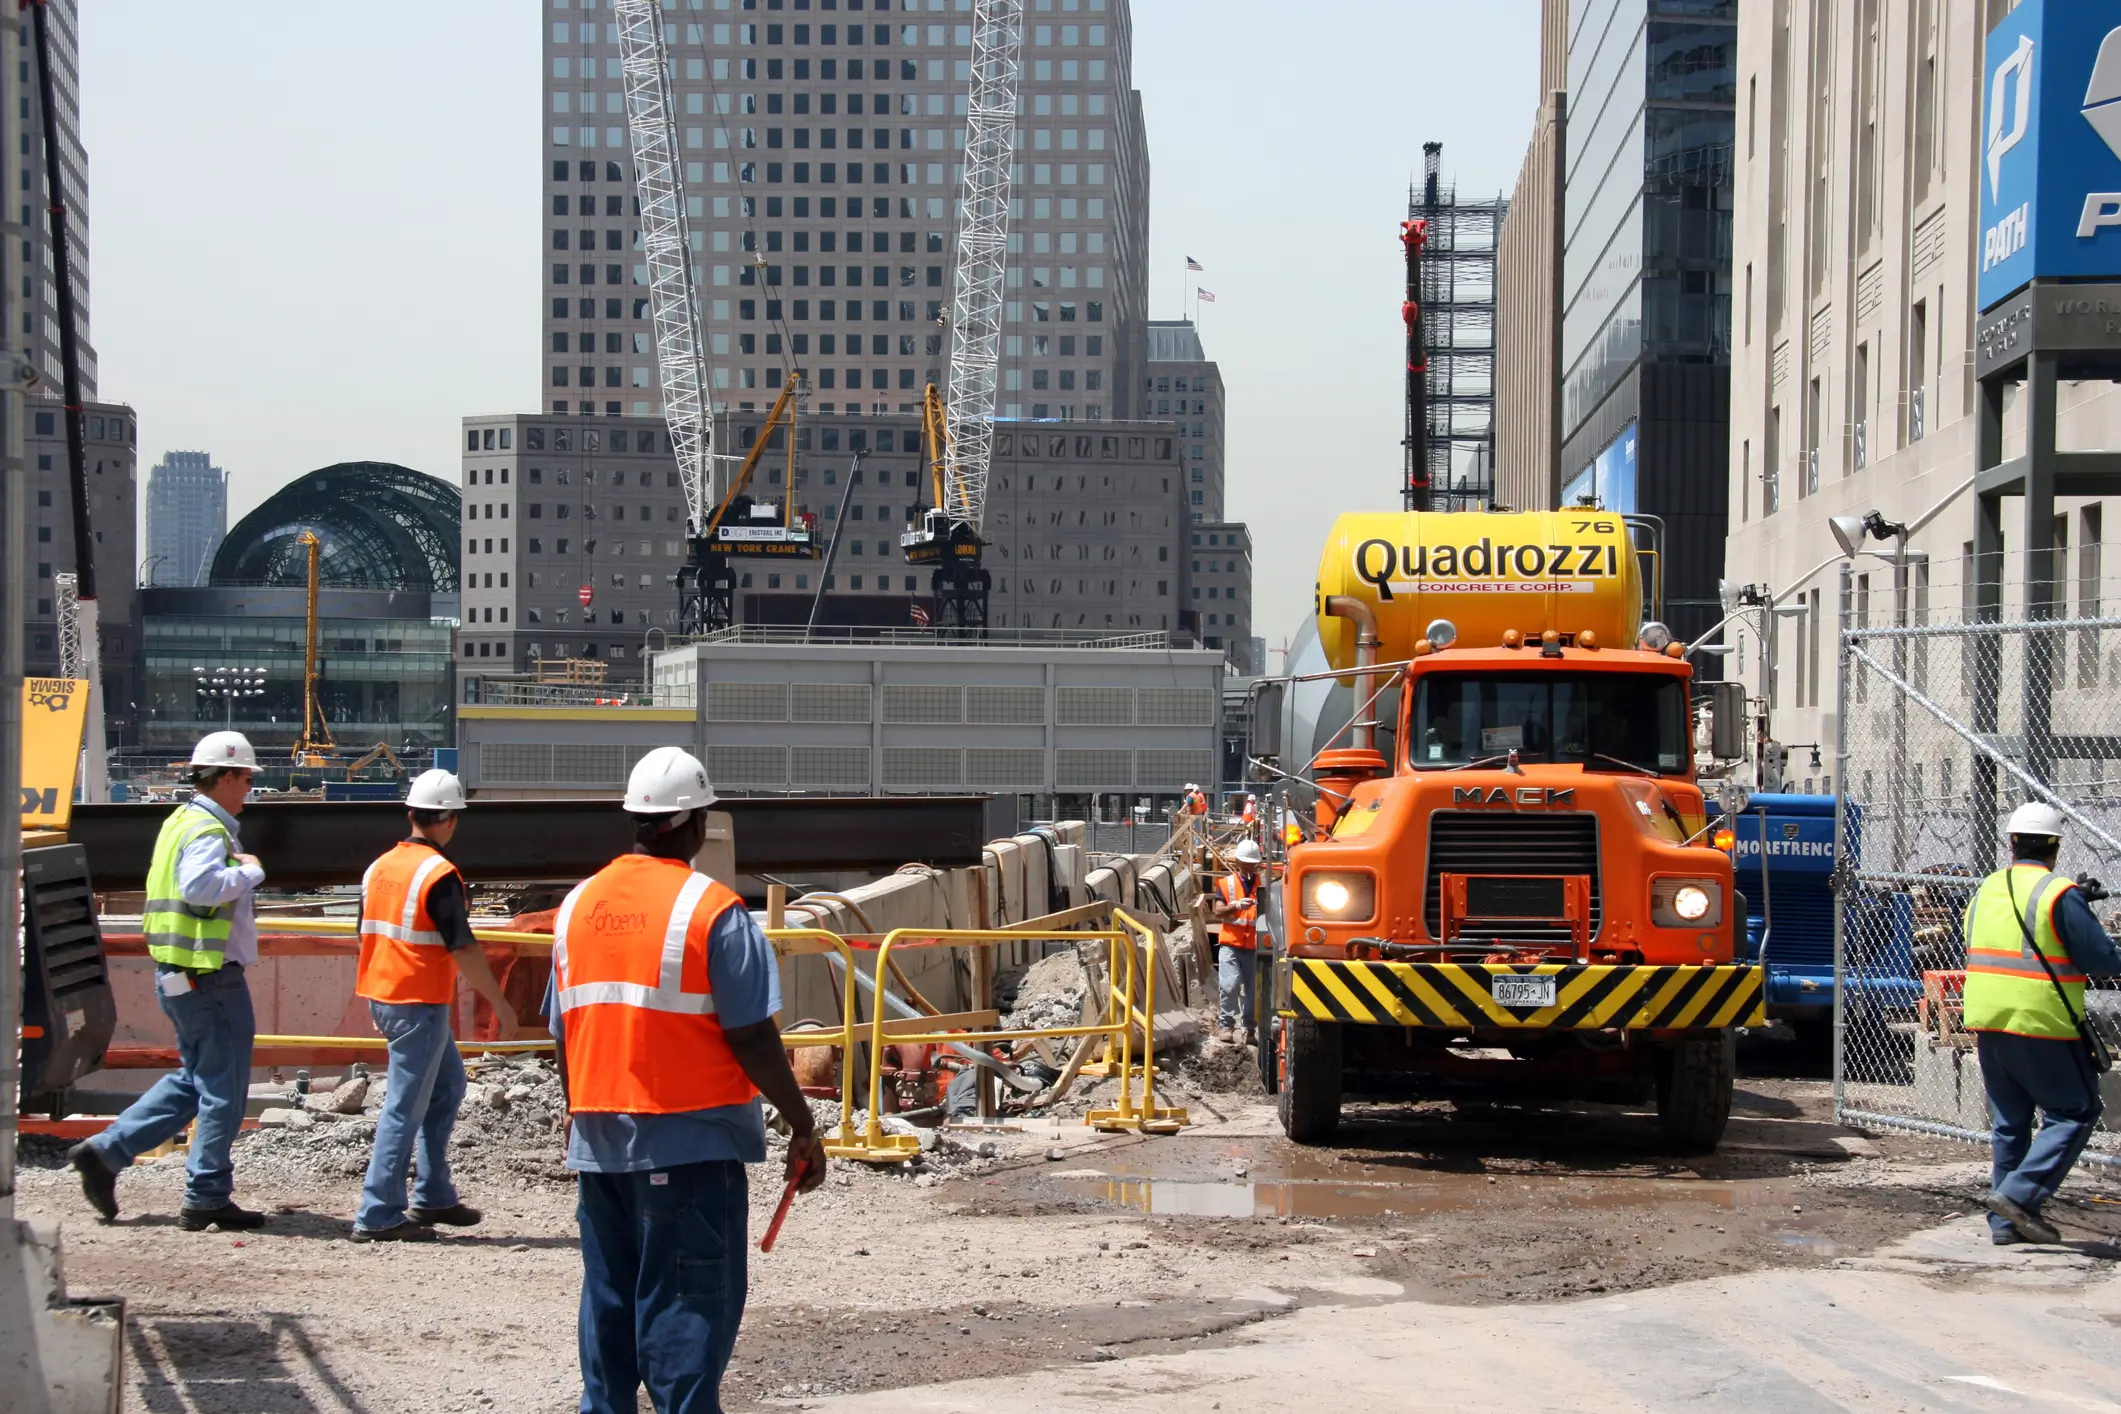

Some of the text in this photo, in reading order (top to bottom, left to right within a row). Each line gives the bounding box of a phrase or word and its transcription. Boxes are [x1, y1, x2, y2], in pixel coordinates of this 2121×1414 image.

[1983, 202, 2029, 274] PATH
[1570, 521, 1615, 534] 76
[710, 543, 797, 554] NEW YORK CRANE
[1355, 537, 1617, 601] Quadrozzi
[1417, 583, 1573, 593] CONCRETE CORP.
[30, 679, 76, 694] SIGMA
[1453, 786, 1575, 804] MACK
[1736, 840, 1836, 857] MORETRENC
